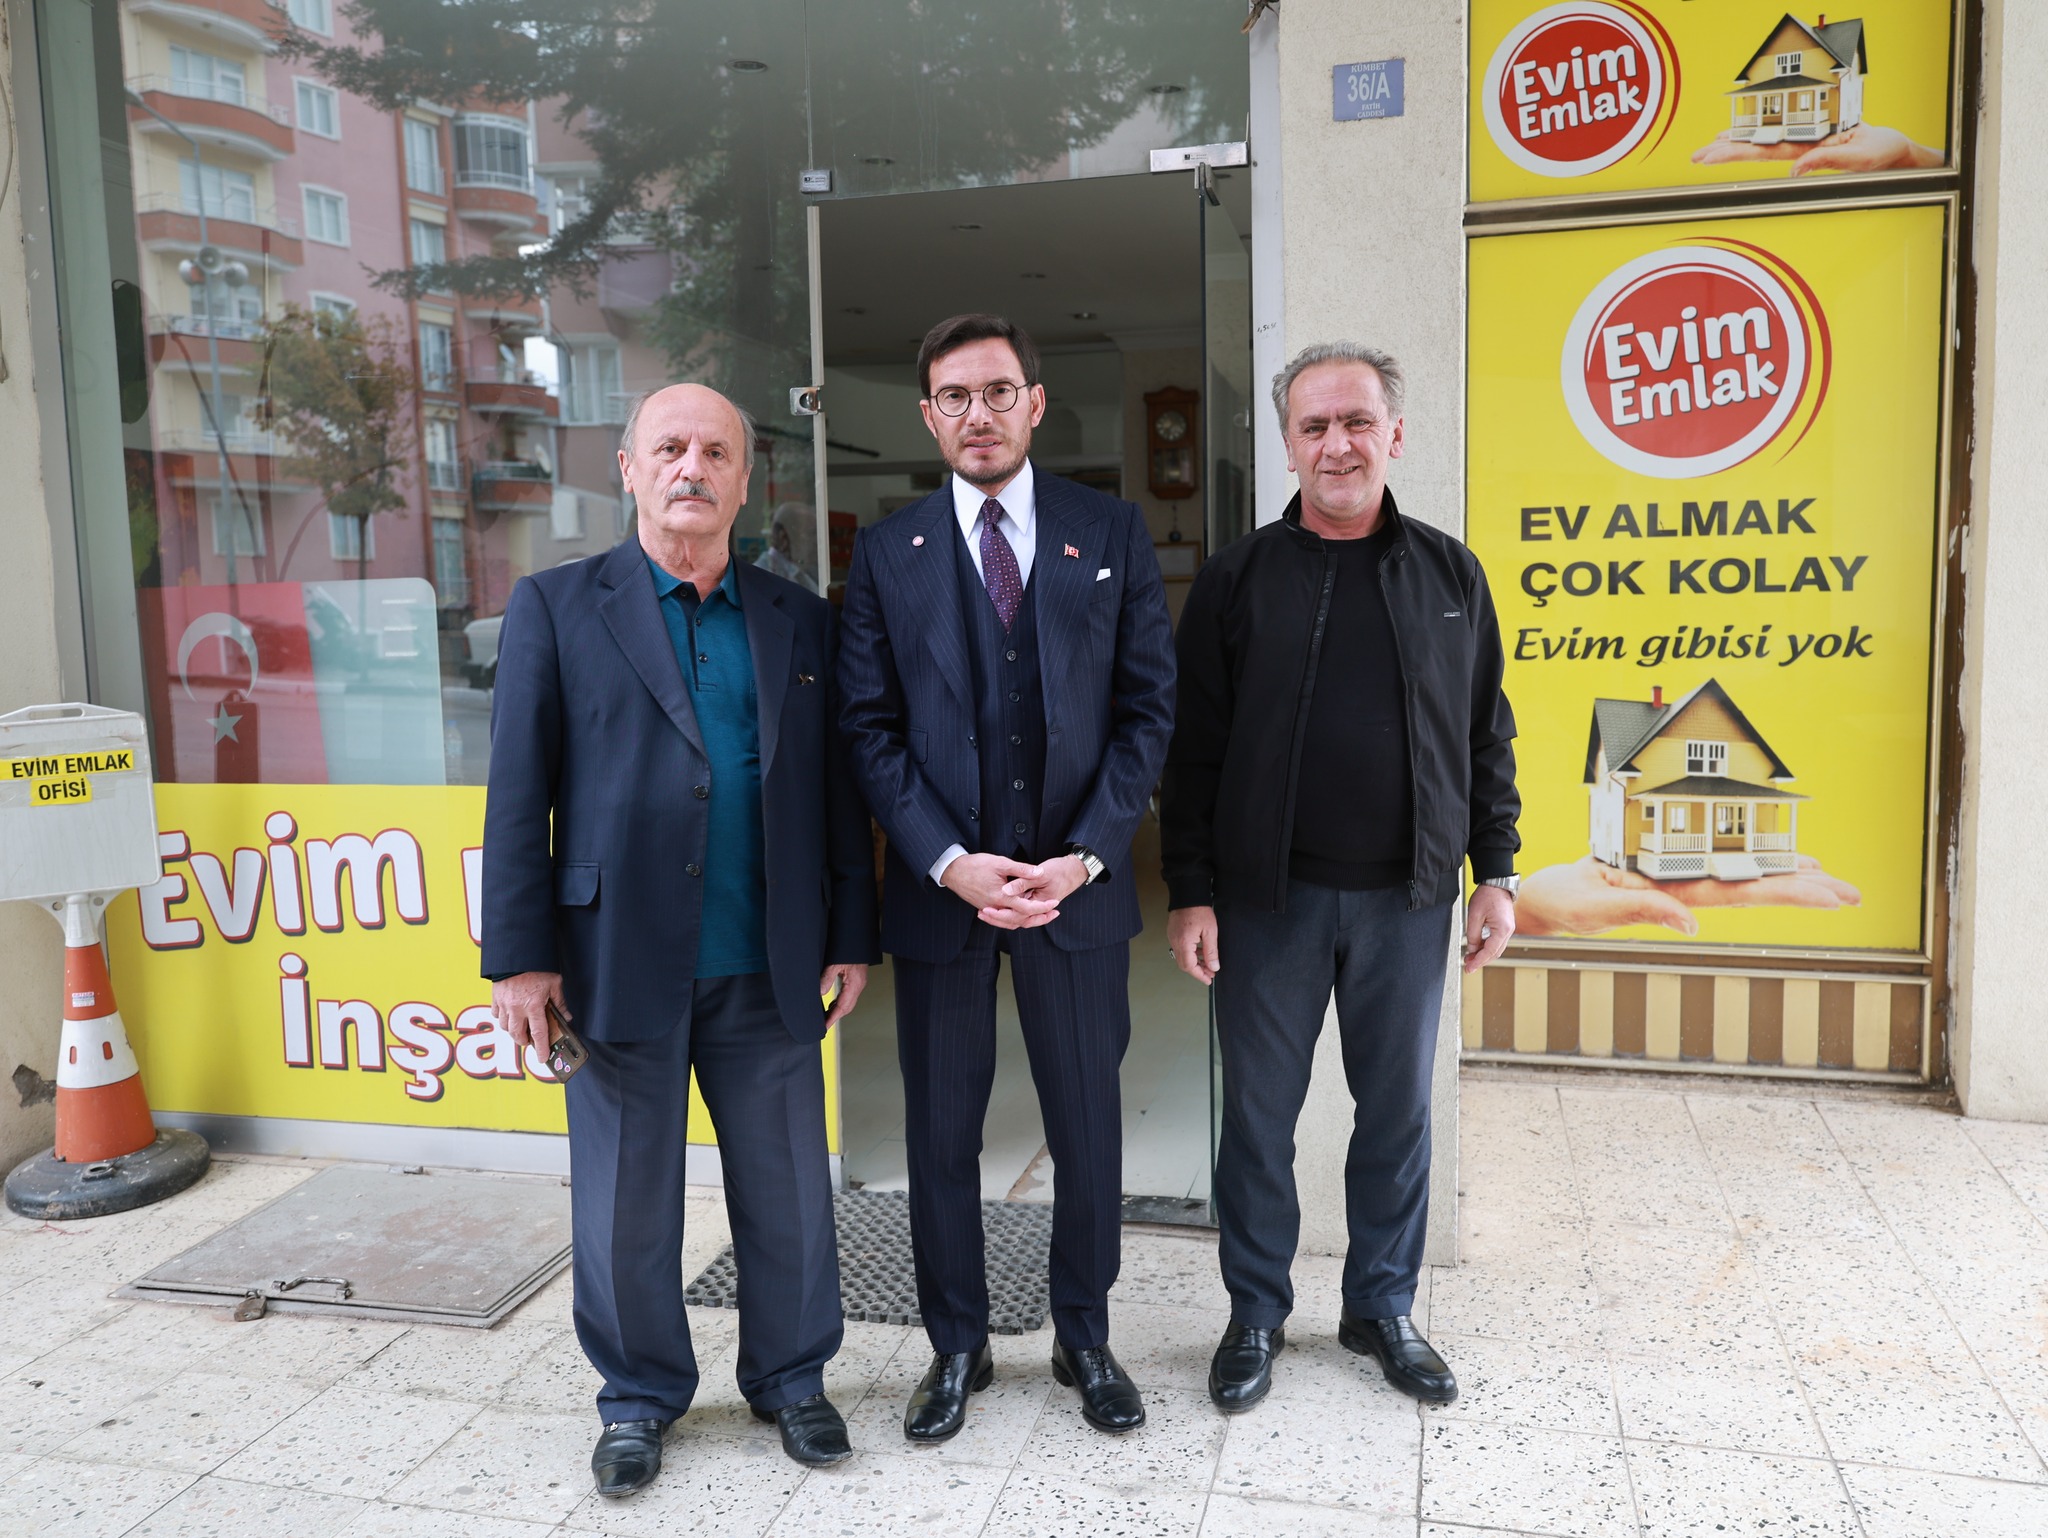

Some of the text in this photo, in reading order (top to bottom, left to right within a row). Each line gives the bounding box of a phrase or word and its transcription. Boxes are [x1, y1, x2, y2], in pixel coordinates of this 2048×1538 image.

[1347, 72, 1391, 102] 36/A
[1351, 62, 1386, 73] KÜMBET
[1513, 44, 1637, 105] Evim
[1357, 108, 1385, 118] CADDESİ
[1361, 102, 1381, 111] FATİH
[1518, 80, 1643, 139] Emlak
[1602, 306, 1771, 380] Evim
[1609, 353, 1780, 426] Emlak
[1521, 498, 1817, 541] EV ALMAK
[1520, 555, 1869, 607] ÇOK KOLAY
[1514, 624, 1873, 667] Evim gibisi yok
[12, 753, 130, 778] EVİM EMLAK
[38, 778, 87, 800] OFİSİ
[137, 810, 429, 951] Evim
[279, 951, 563, 1102] İnşa
